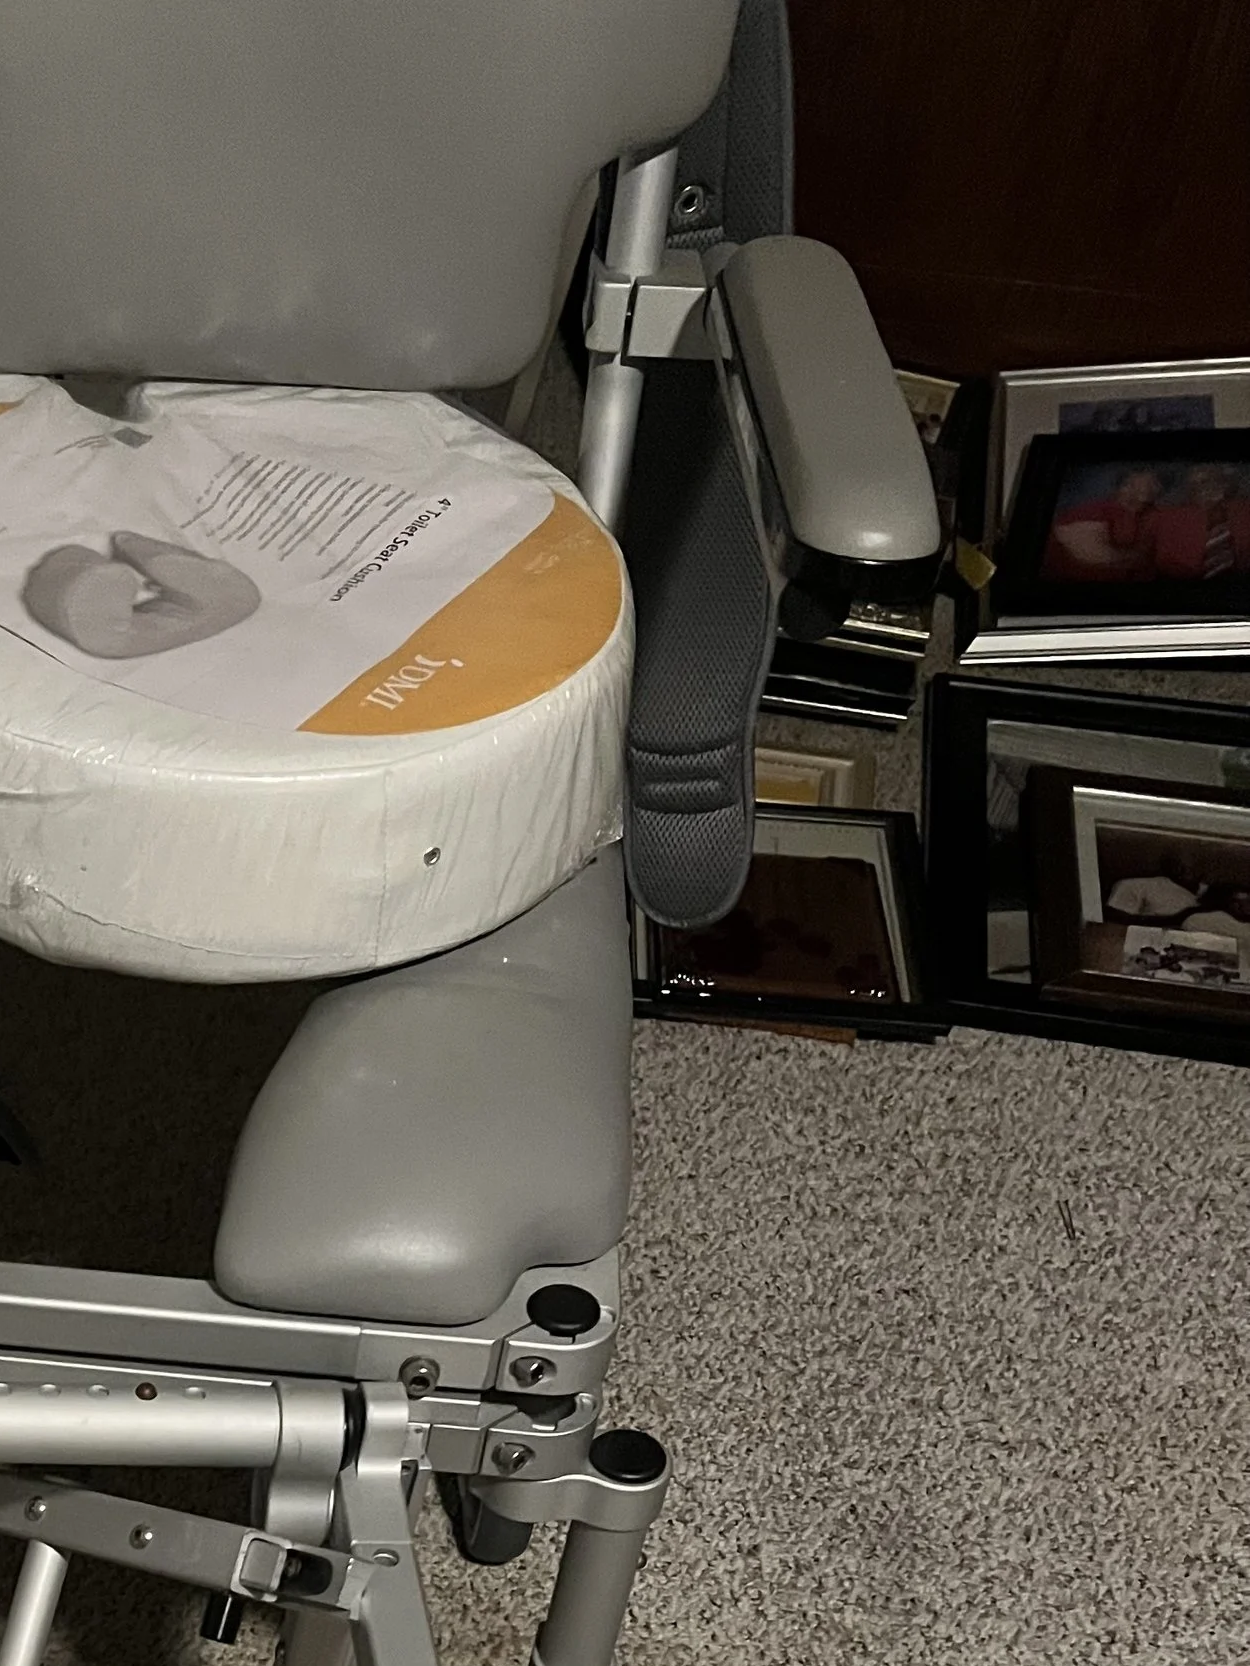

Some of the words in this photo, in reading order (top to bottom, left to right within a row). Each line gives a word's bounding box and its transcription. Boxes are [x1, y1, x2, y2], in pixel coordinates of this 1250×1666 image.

[400, 510, 442, 537] Toilet
[374, 536, 409, 562] Seat
[329, 562, 382, 602] Cushion
[365, 664, 437, 711] DMI
